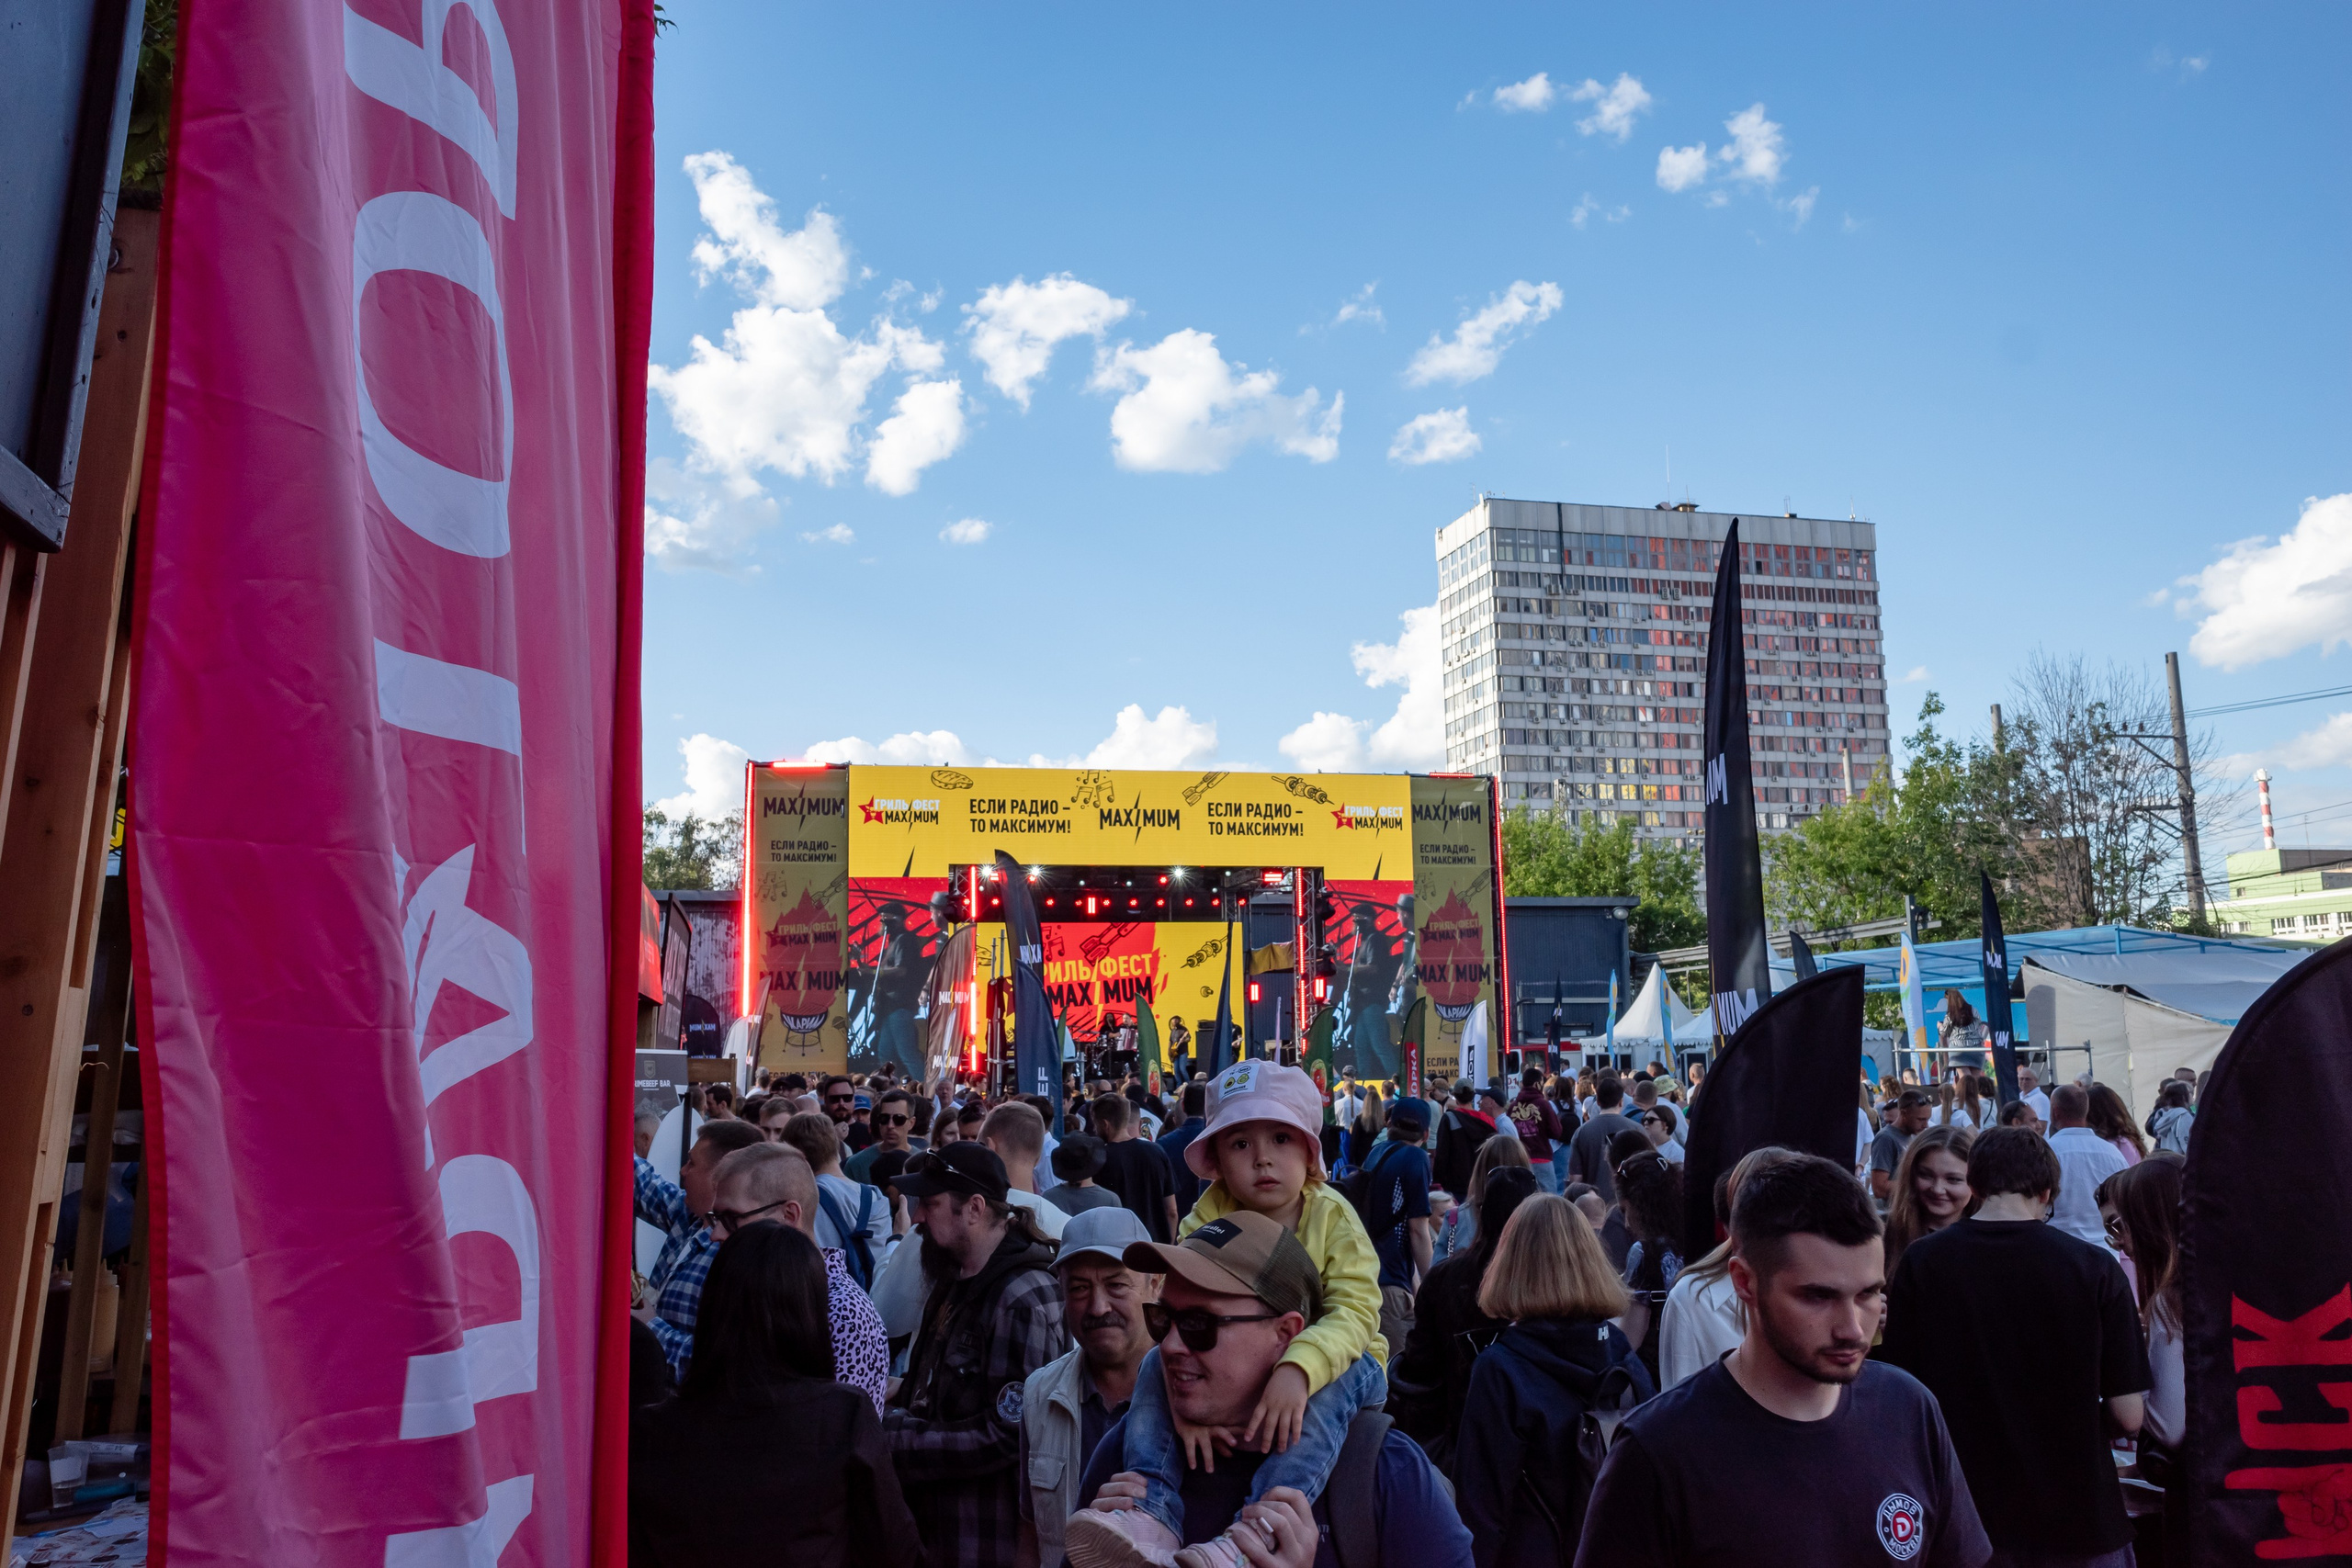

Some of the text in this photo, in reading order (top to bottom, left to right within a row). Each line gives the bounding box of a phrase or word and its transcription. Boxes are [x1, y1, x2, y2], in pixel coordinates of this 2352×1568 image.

[763, 796, 844, 818] MAXIMUM
[969, 798, 1006, 814] ЕСЛИ
[1011, 799, 1058, 817] РАДИО
[1207, 802, 1242, 817] ЕСЛИ
[1247, 804, 1291, 820] РАДИО
[970, 818, 1070, 833] ТО МАКСИМУМ!
[1100, 808, 1180, 830] MAXIMUM
[1208, 821, 1304, 836] ТО МАКСИМУМ!
[771, 840, 795, 850] ЕСЛИ
[797, 840, 829, 852] РАДИО
[1419, 843, 1440, 853] ЕСЛИ
[1442, 844, 1469, 855] РАДИО
[771, 852, 836, 863] ТО МАКСИМУМ!
[1420, 855, 1476, 864] ТО МАКСИМУМ!
[1044, 953, 1153, 983] ИЛЬ ФЕСТ
[1427, 1057, 1447, 1067] ЕСЛИ
[1409, 1049, 1419, 1098] ОРКА
[660, 1079, 671, 1088] BAR
[1883, 1499, 1917, 1521] ДЫМОВ
[1888, 1535, 1919, 1554] МОСКВА
